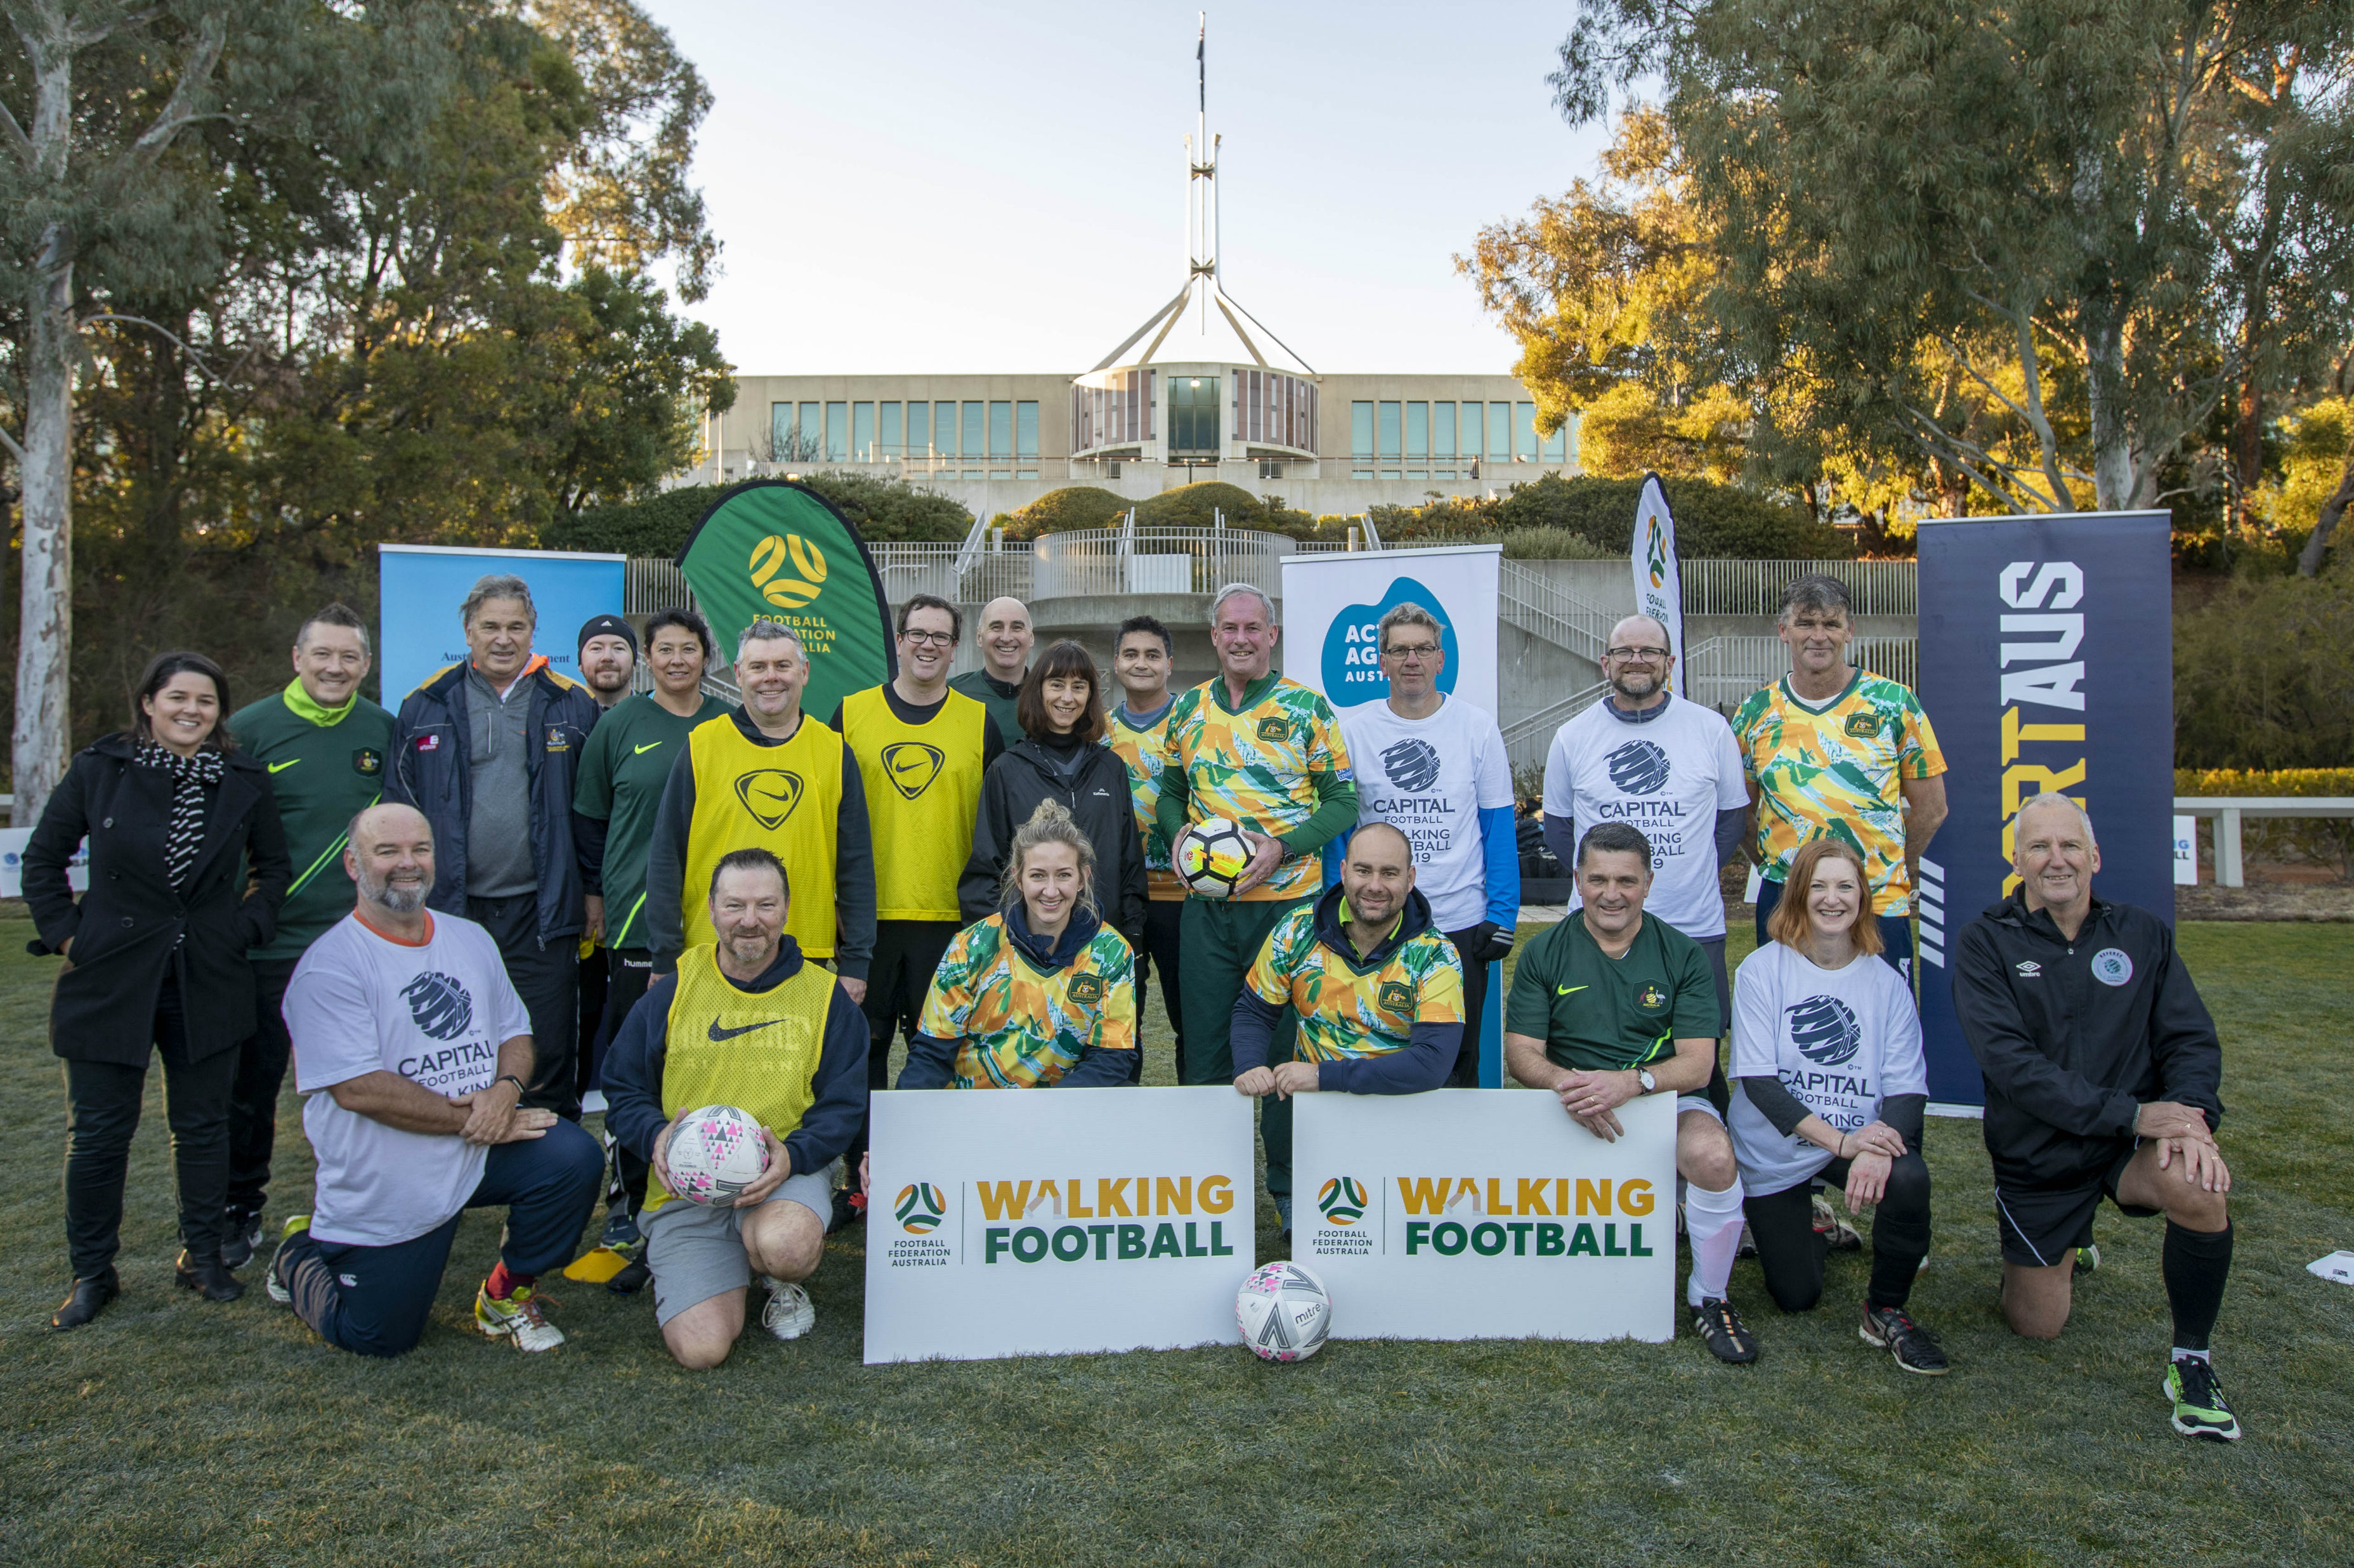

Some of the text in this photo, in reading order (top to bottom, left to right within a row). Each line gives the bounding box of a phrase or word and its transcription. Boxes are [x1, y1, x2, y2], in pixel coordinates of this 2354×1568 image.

[793, 629, 836, 641] ATION
[1345, 624, 1380, 643] AC
[802, 643, 831, 653] ALIA
[441, 652, 468, 662] Aust
[1345, 646, 1378, 665] AG
[1345, 670, 1390, 682] AUST
[1373, 798, 1456, 814] CAPITAL
[1599, 801, 1687, 819] CAPITAL
[1385, 816, 1443, 824] FOOTBALL
[1403, 829, 1450, 840] LKING
[1645, 833, 1682, 844] KING
[1410, 840, 1452, 851] BALL
[1415, 853, 1431, 863] 19
[624, 958, 653, 967] humme
[398, 1040, 494, 1078] CAPITAL
[418, 1064, 492, 1087] FOOTBALL
[1777, 1069, 1876, 1098] CAPITAL
[1791, 1088, 1859, 1109] FOOTBALL
[976, 1175, 1234, 1220] WALKING
[1397, 1177, 1655, 1217] WALKING
[1318, 1230, 1368, 1238] FOOTBALL
[1406, 1221, 1654, 1257] FOOTBALL
[894, 1239, 945, 1248] FOOTBALL
[985, 1221, 1234, 1264] FOOTBALL
[1312, 1238, 1373, 1246] FEDERATION
[888, 1248, 951, 1258] FEDERATION
[1316, 1247, 1370, 1255] AUSTRALIA
[892, 1258, 947, 1267] AUSTRALIA
[1295, 1303, 1321, 1324] mitre
